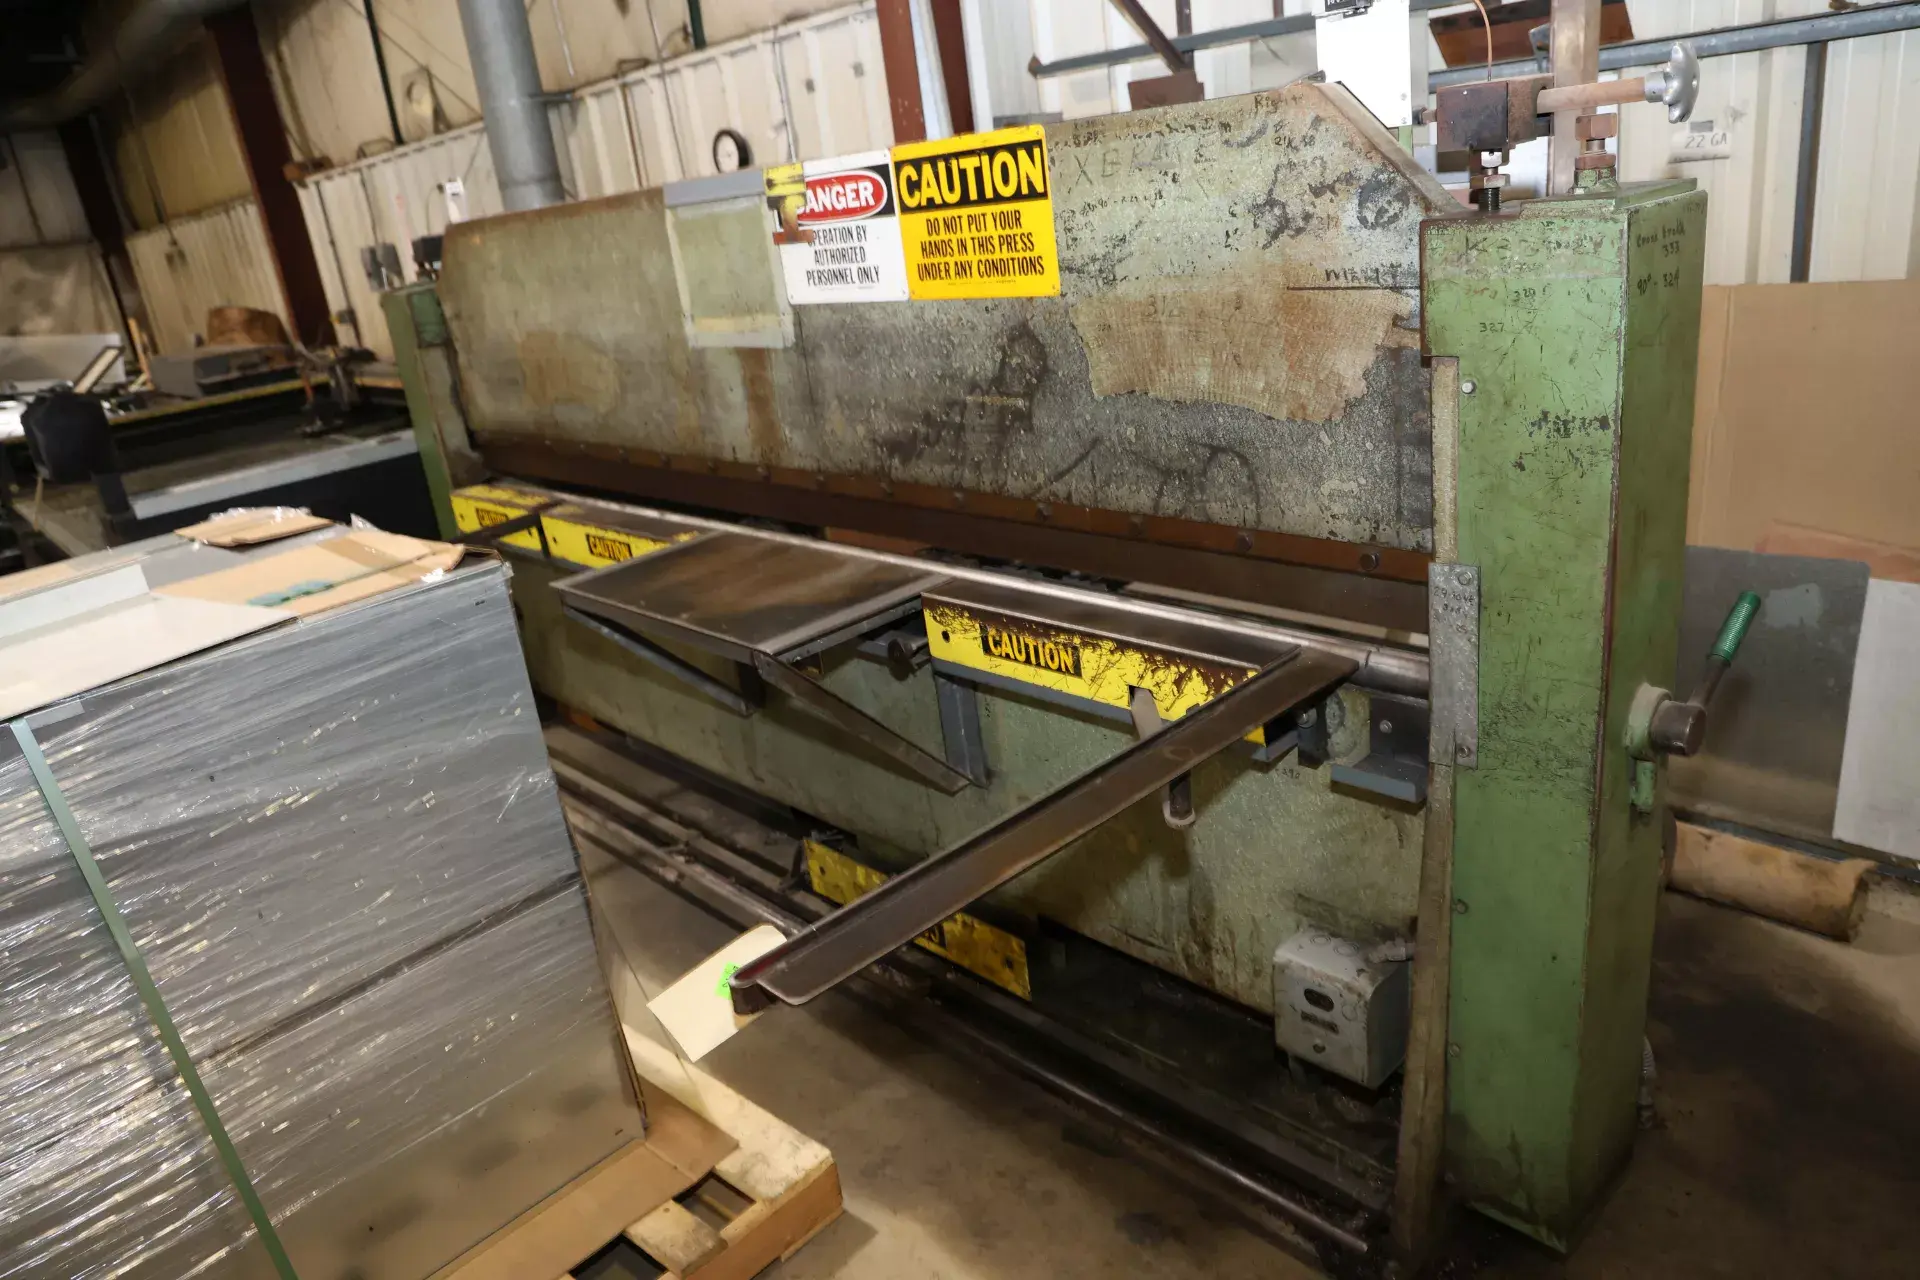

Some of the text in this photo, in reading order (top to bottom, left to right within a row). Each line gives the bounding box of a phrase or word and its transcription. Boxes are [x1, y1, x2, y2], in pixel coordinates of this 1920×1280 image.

[899, 145, 1045, 208] CAUTION
[797, 181, 875, 214] ANGER
[807, 224, 868, 247] PERATION BY
[925, 209, 1023, 237] DO NOT PUT YOUR
[814, 245, 867, 267] AUTHORIZED
[920, 231, 1036, 260] HANDS IN THIS PRESS
[806, 265, 881, 287] PERSONNEL ONLY
[917, 255, 1045, 282] UNDER ANY CONDITIONS
[590, 536, 632, 562] CAUTION
[987, 627, 1075, 675] CAUTION
